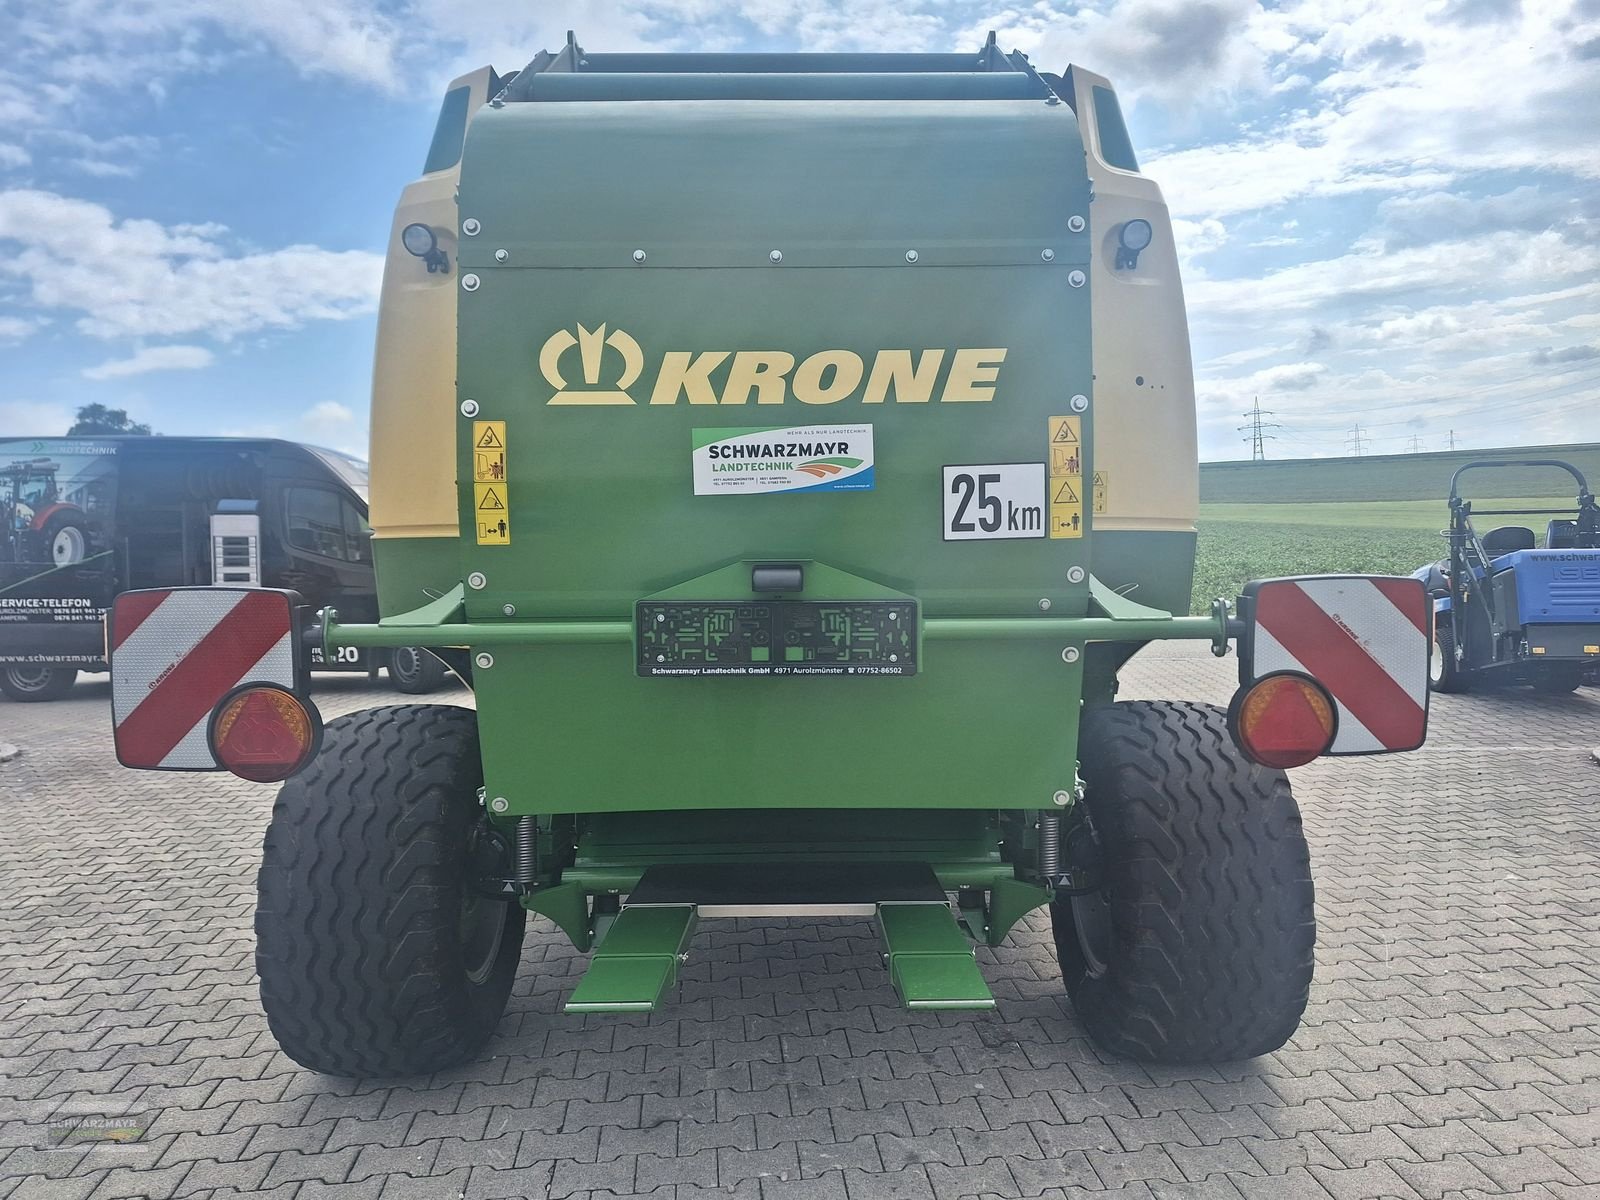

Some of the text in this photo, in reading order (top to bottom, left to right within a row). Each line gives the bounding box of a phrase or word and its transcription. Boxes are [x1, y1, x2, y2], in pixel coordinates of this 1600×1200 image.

[649, 347, 1008, 405] KRONE
[708, 442, 849, 459] SCHWARZMAYR
[712, 462, 794, 473] LANDTECHNIK
[951, 473, 1041, 532] 25 km
[1530, 553, 1600, 562] www.schwar
